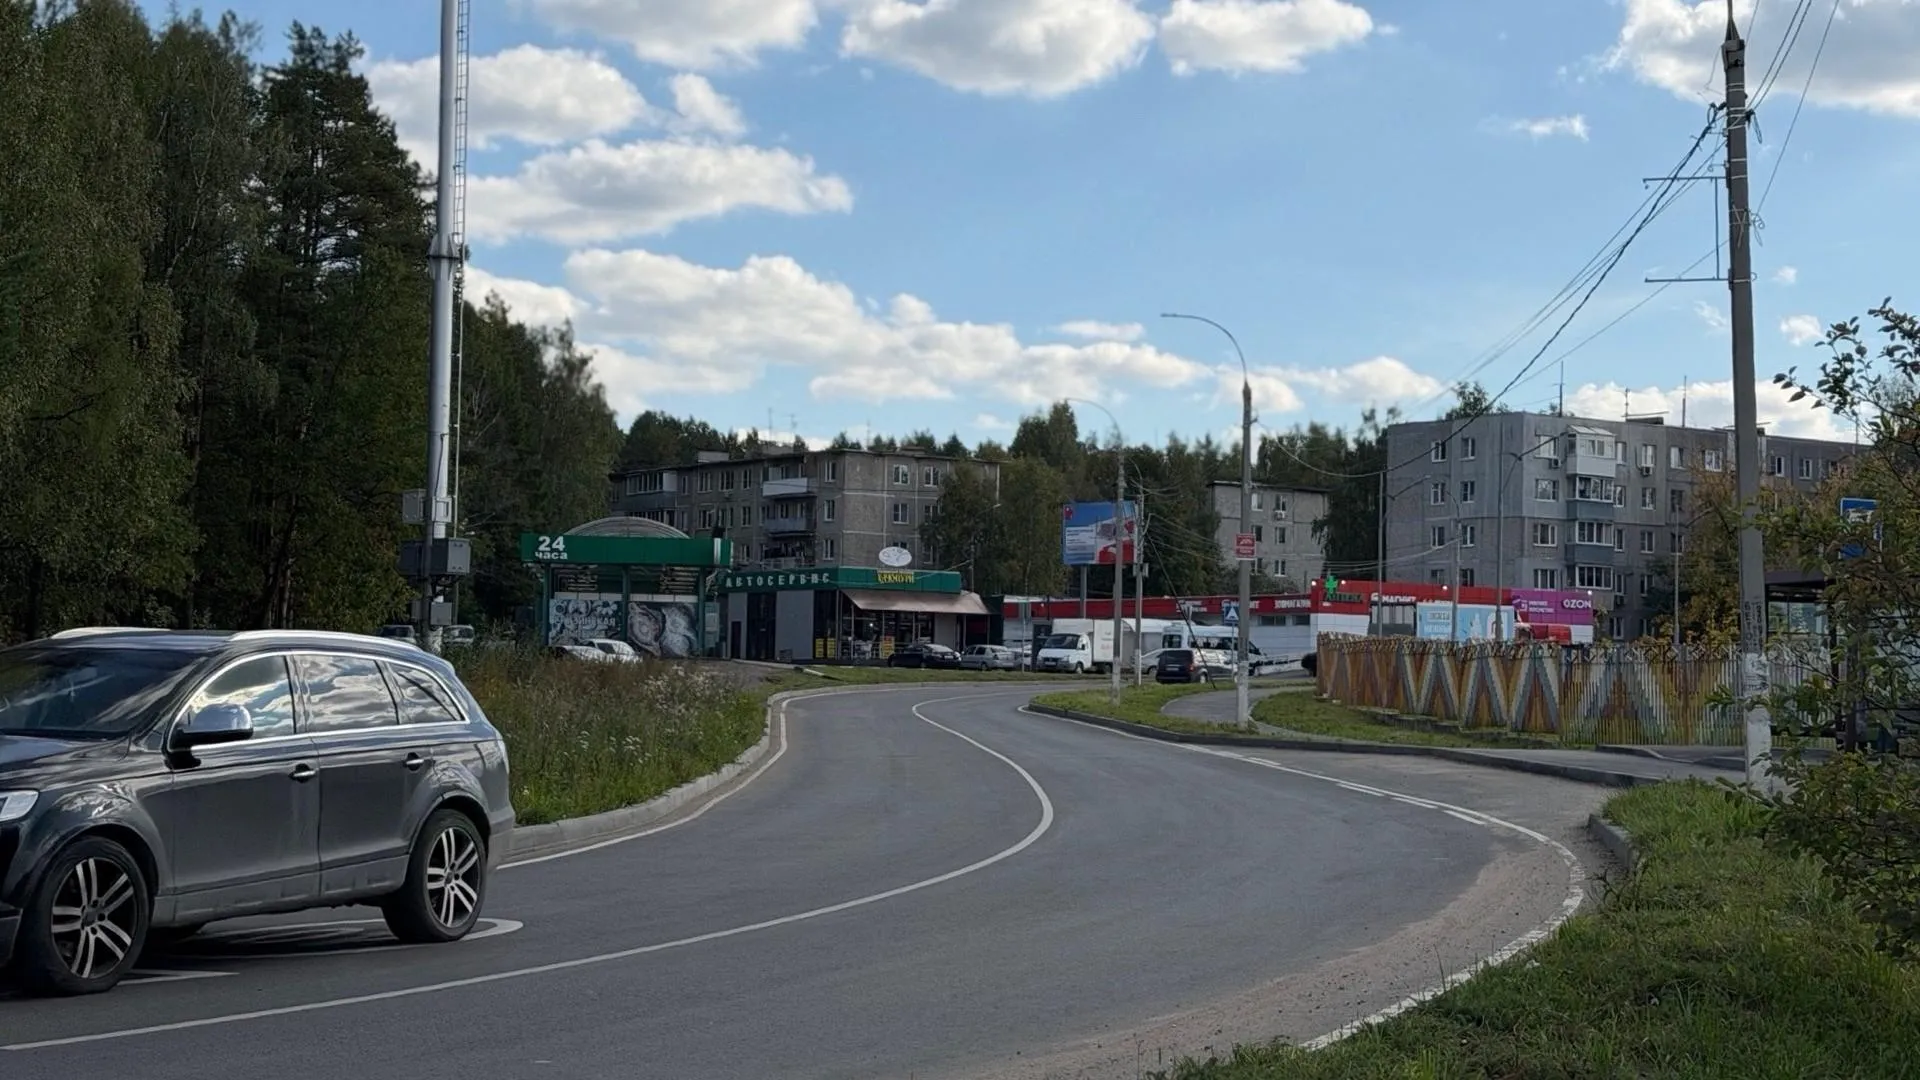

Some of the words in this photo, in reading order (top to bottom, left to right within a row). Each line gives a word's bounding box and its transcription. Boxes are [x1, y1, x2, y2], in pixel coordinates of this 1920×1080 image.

[538, 535, 566, 551] 24
[534, 551, 568, 560] часа
[725, 572, 830, 588] АВТОСЕРВИС
[1563, 599, 1592, 609] OZON
